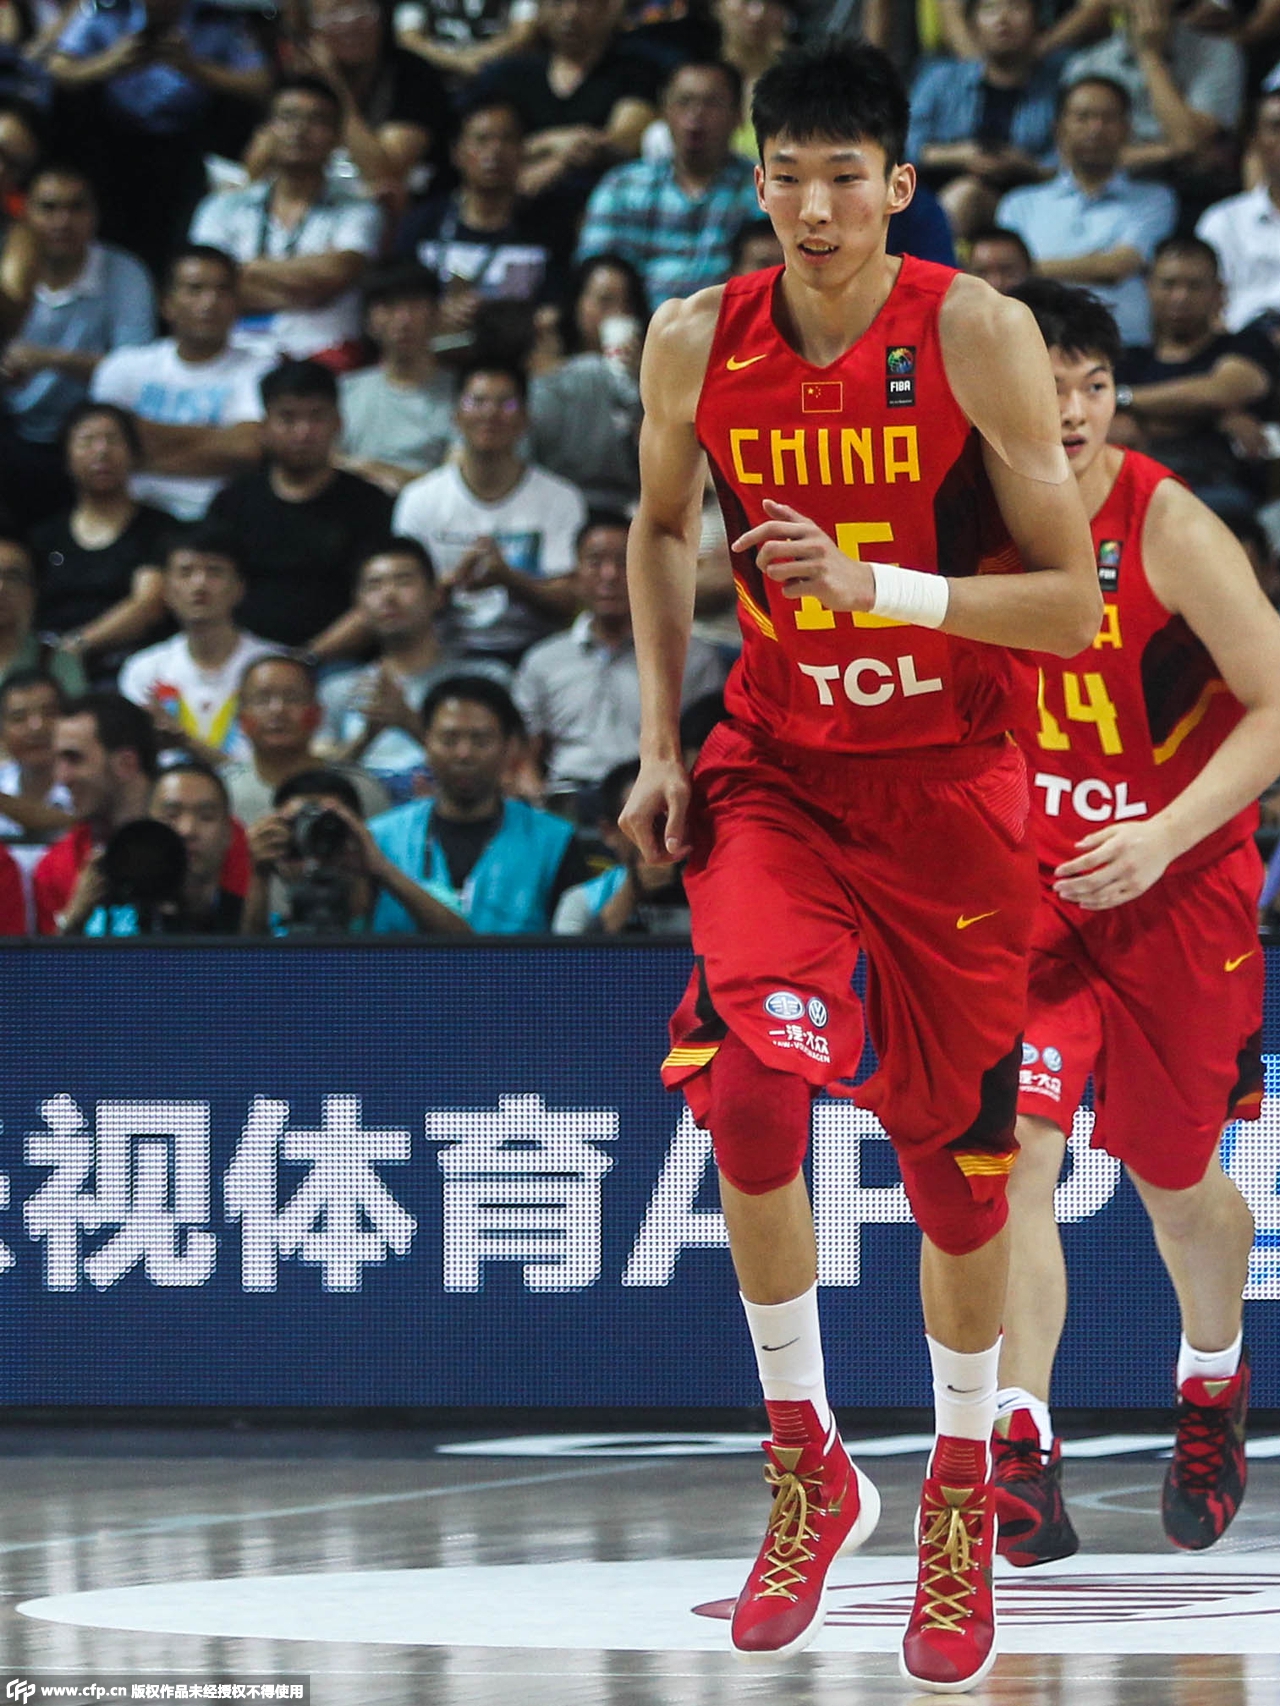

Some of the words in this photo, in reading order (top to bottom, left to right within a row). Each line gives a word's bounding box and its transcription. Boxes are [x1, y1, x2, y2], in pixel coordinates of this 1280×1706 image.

[730, 426, 921, 486] CHINA
[798, 655, 943, 706] TCL
[1037, 667, 1123, 756] 14
[1034, 772, 1147, 822] TCL
